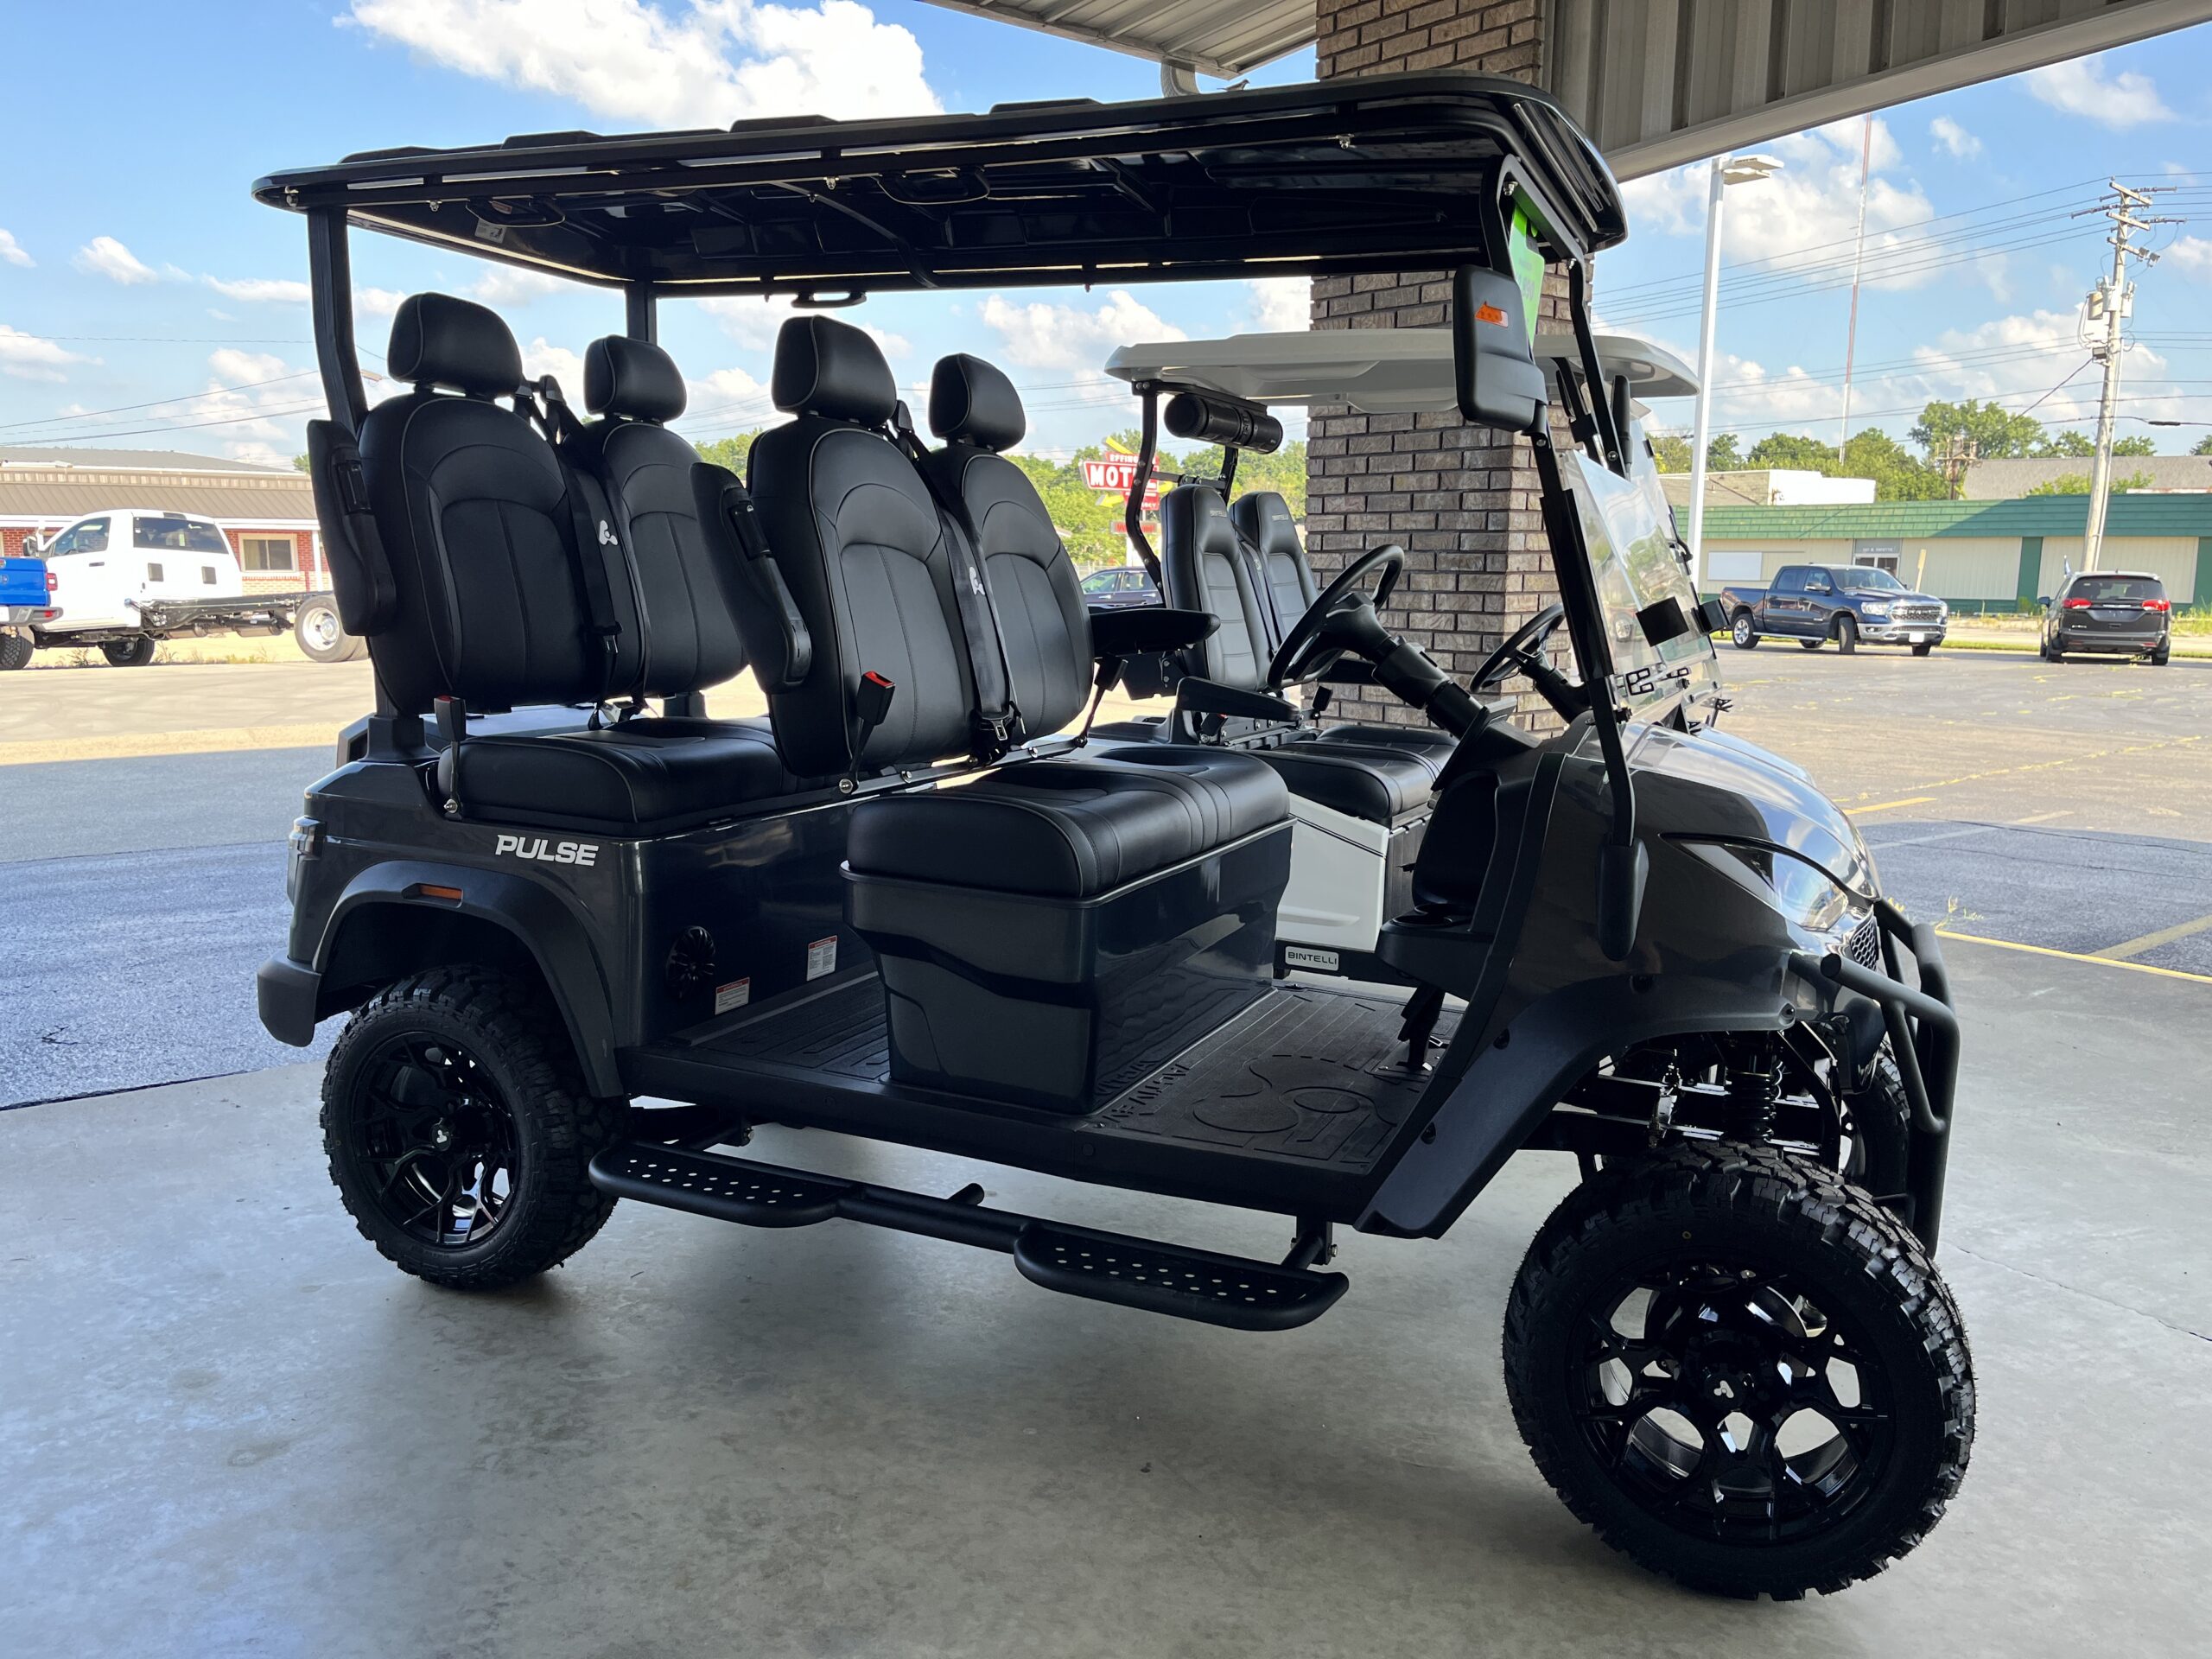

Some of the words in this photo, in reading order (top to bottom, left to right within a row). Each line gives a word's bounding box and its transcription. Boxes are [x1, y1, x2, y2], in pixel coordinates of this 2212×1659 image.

[1109, 454, 1156, 464] EFFING
[1090, 465, 1156, 488] MOT
[494, 834, 599, 867] PULSE
[1287, 951, 1337, 965] BINTELLI
